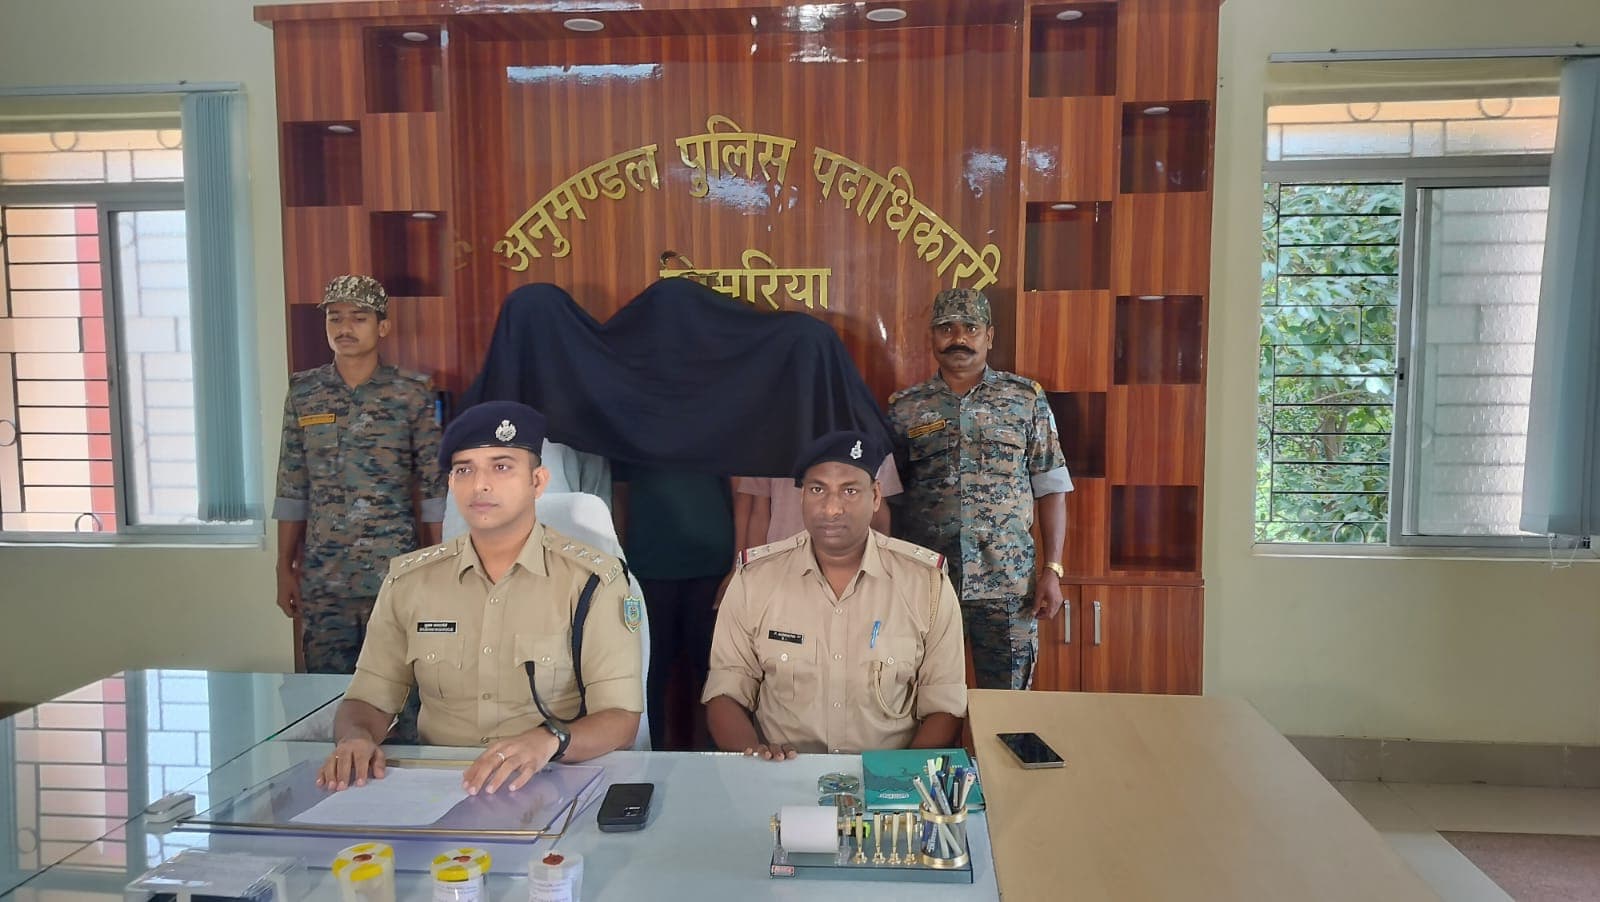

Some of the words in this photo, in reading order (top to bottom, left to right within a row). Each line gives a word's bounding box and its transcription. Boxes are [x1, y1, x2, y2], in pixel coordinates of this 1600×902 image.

[492, 143, 660, 272] अनुमण्डल
[675, 114, 797, 197] पुलिस
[812, 146, 1001, 291] पदाधिकारी
[659, 249, 832, 310] िमरिया
